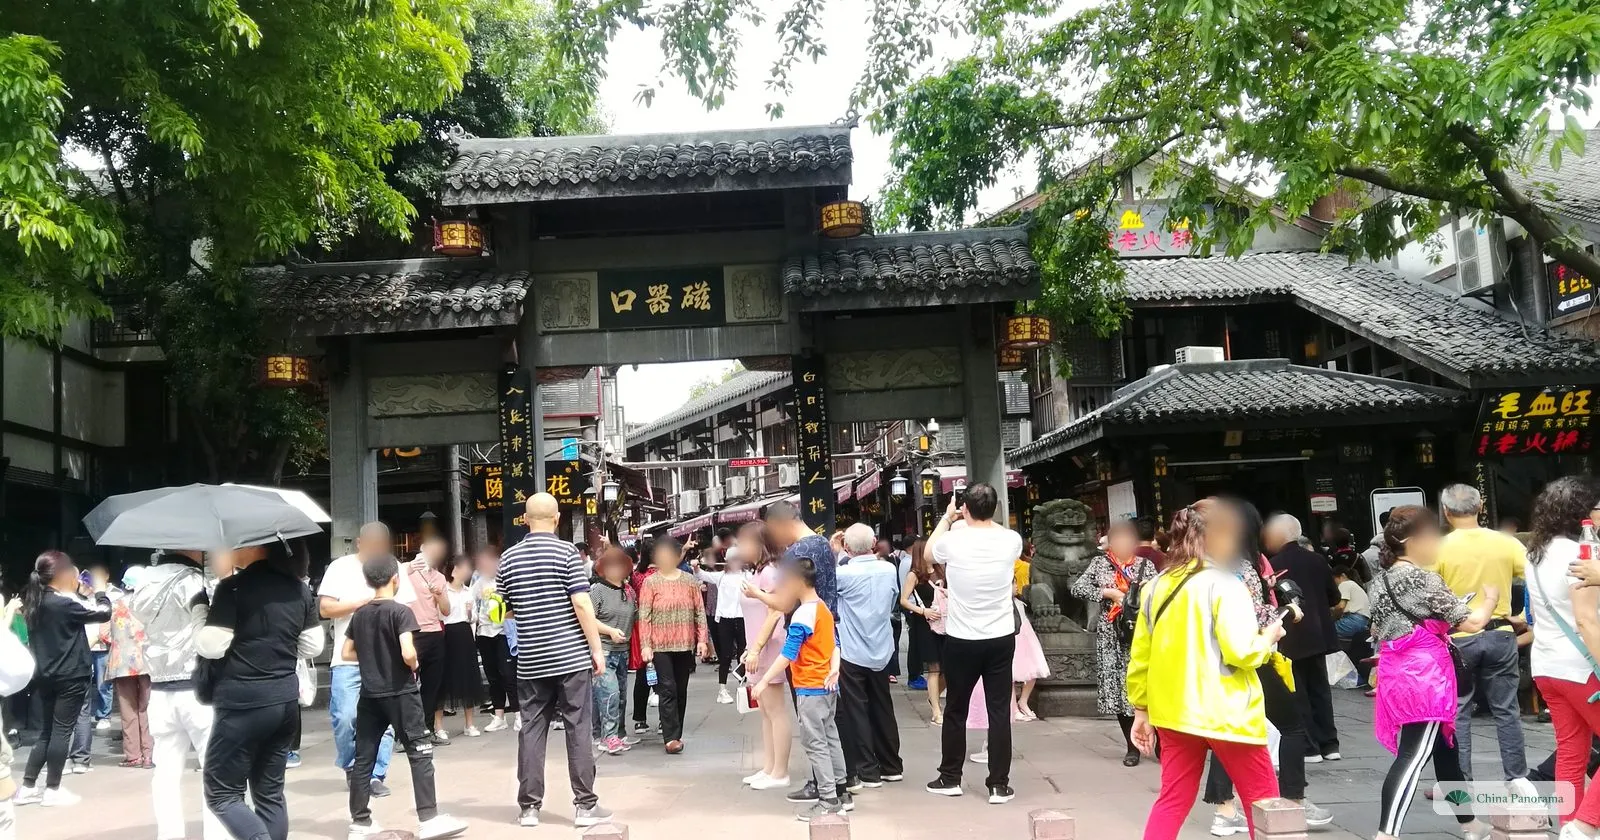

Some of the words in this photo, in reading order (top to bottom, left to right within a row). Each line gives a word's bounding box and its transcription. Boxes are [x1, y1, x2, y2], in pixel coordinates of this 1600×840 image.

[610, 280, 712, 315] 磁器口
[1492, 390, 1592, 418] 毛血旺
